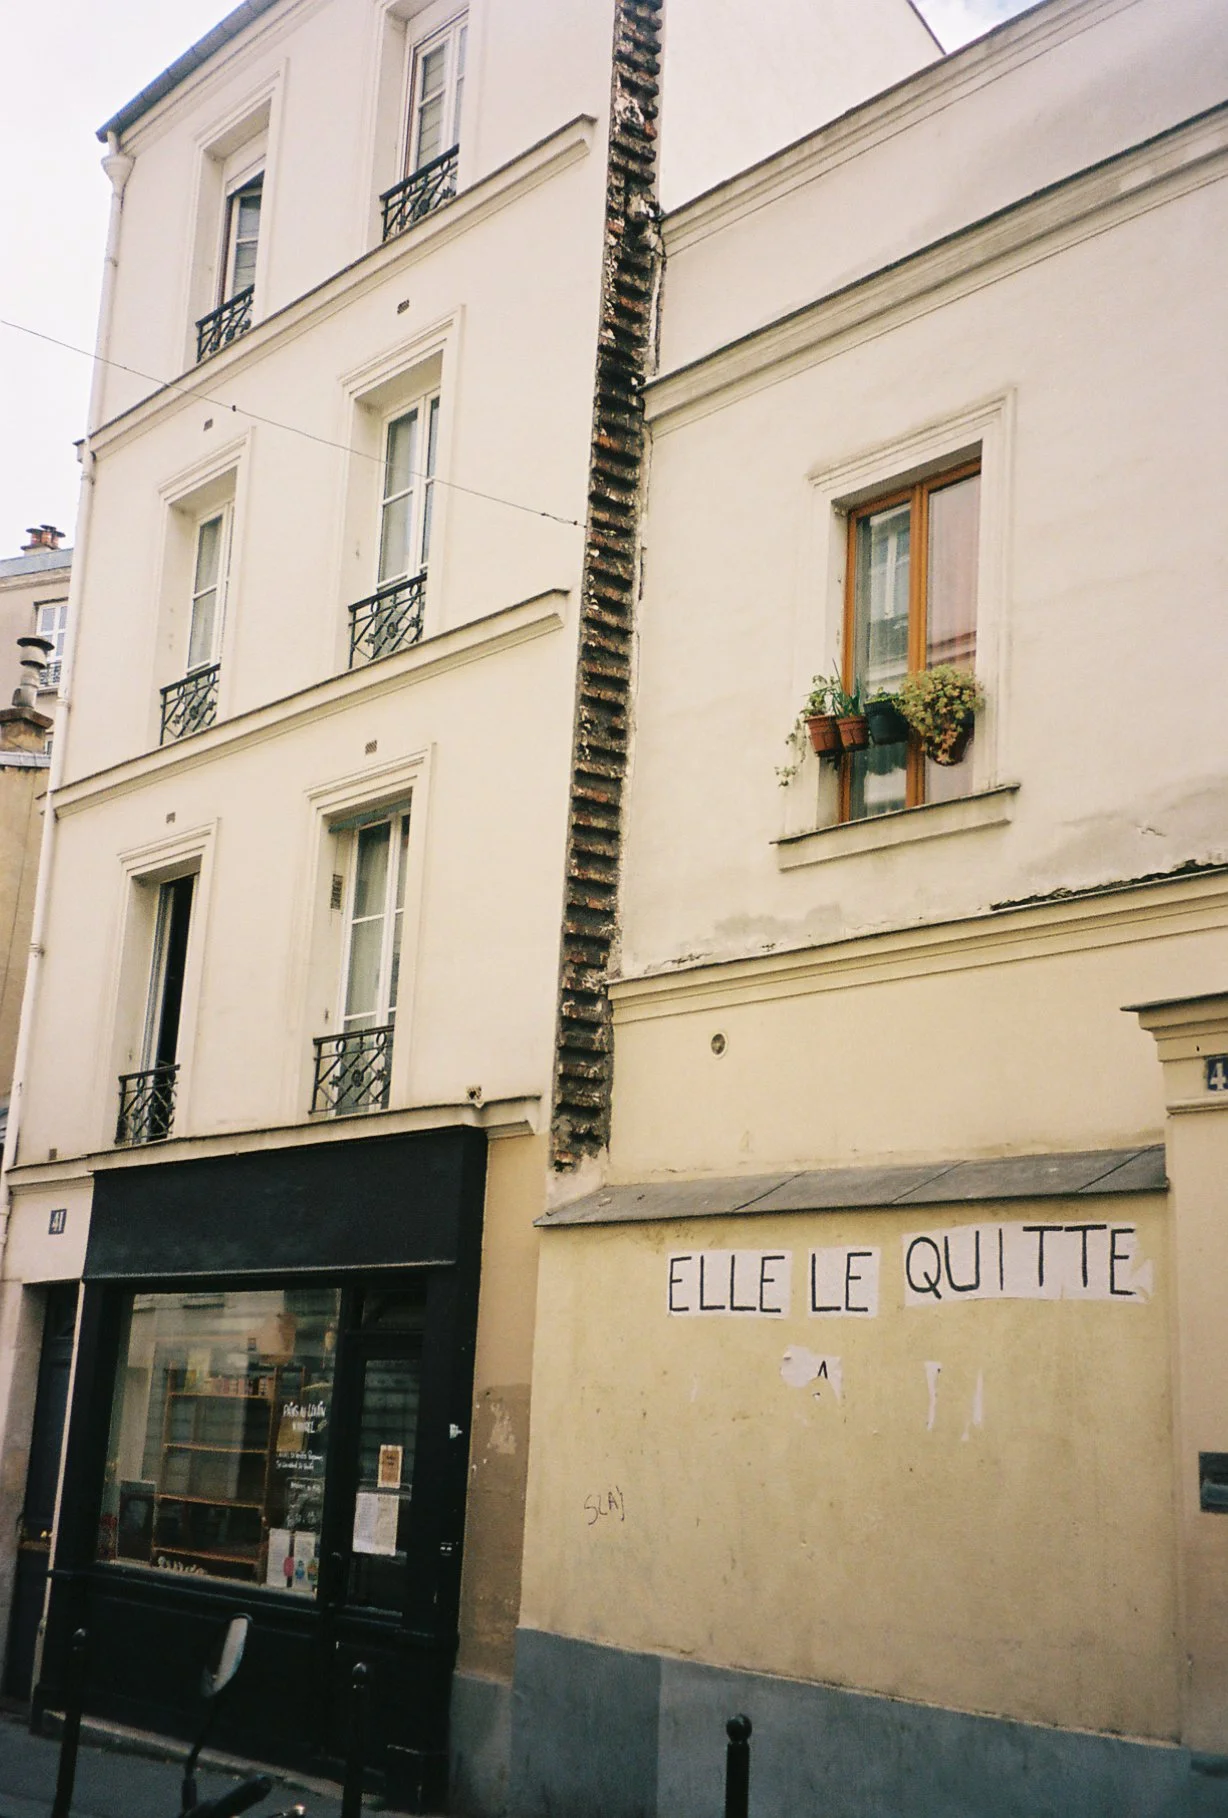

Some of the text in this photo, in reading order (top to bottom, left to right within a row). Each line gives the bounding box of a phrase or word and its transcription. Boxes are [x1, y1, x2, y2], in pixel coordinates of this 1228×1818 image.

[52, 1211, 65, 1232] 41
[668, 1224, 1137, 1313] ELLE LE QUITTE
